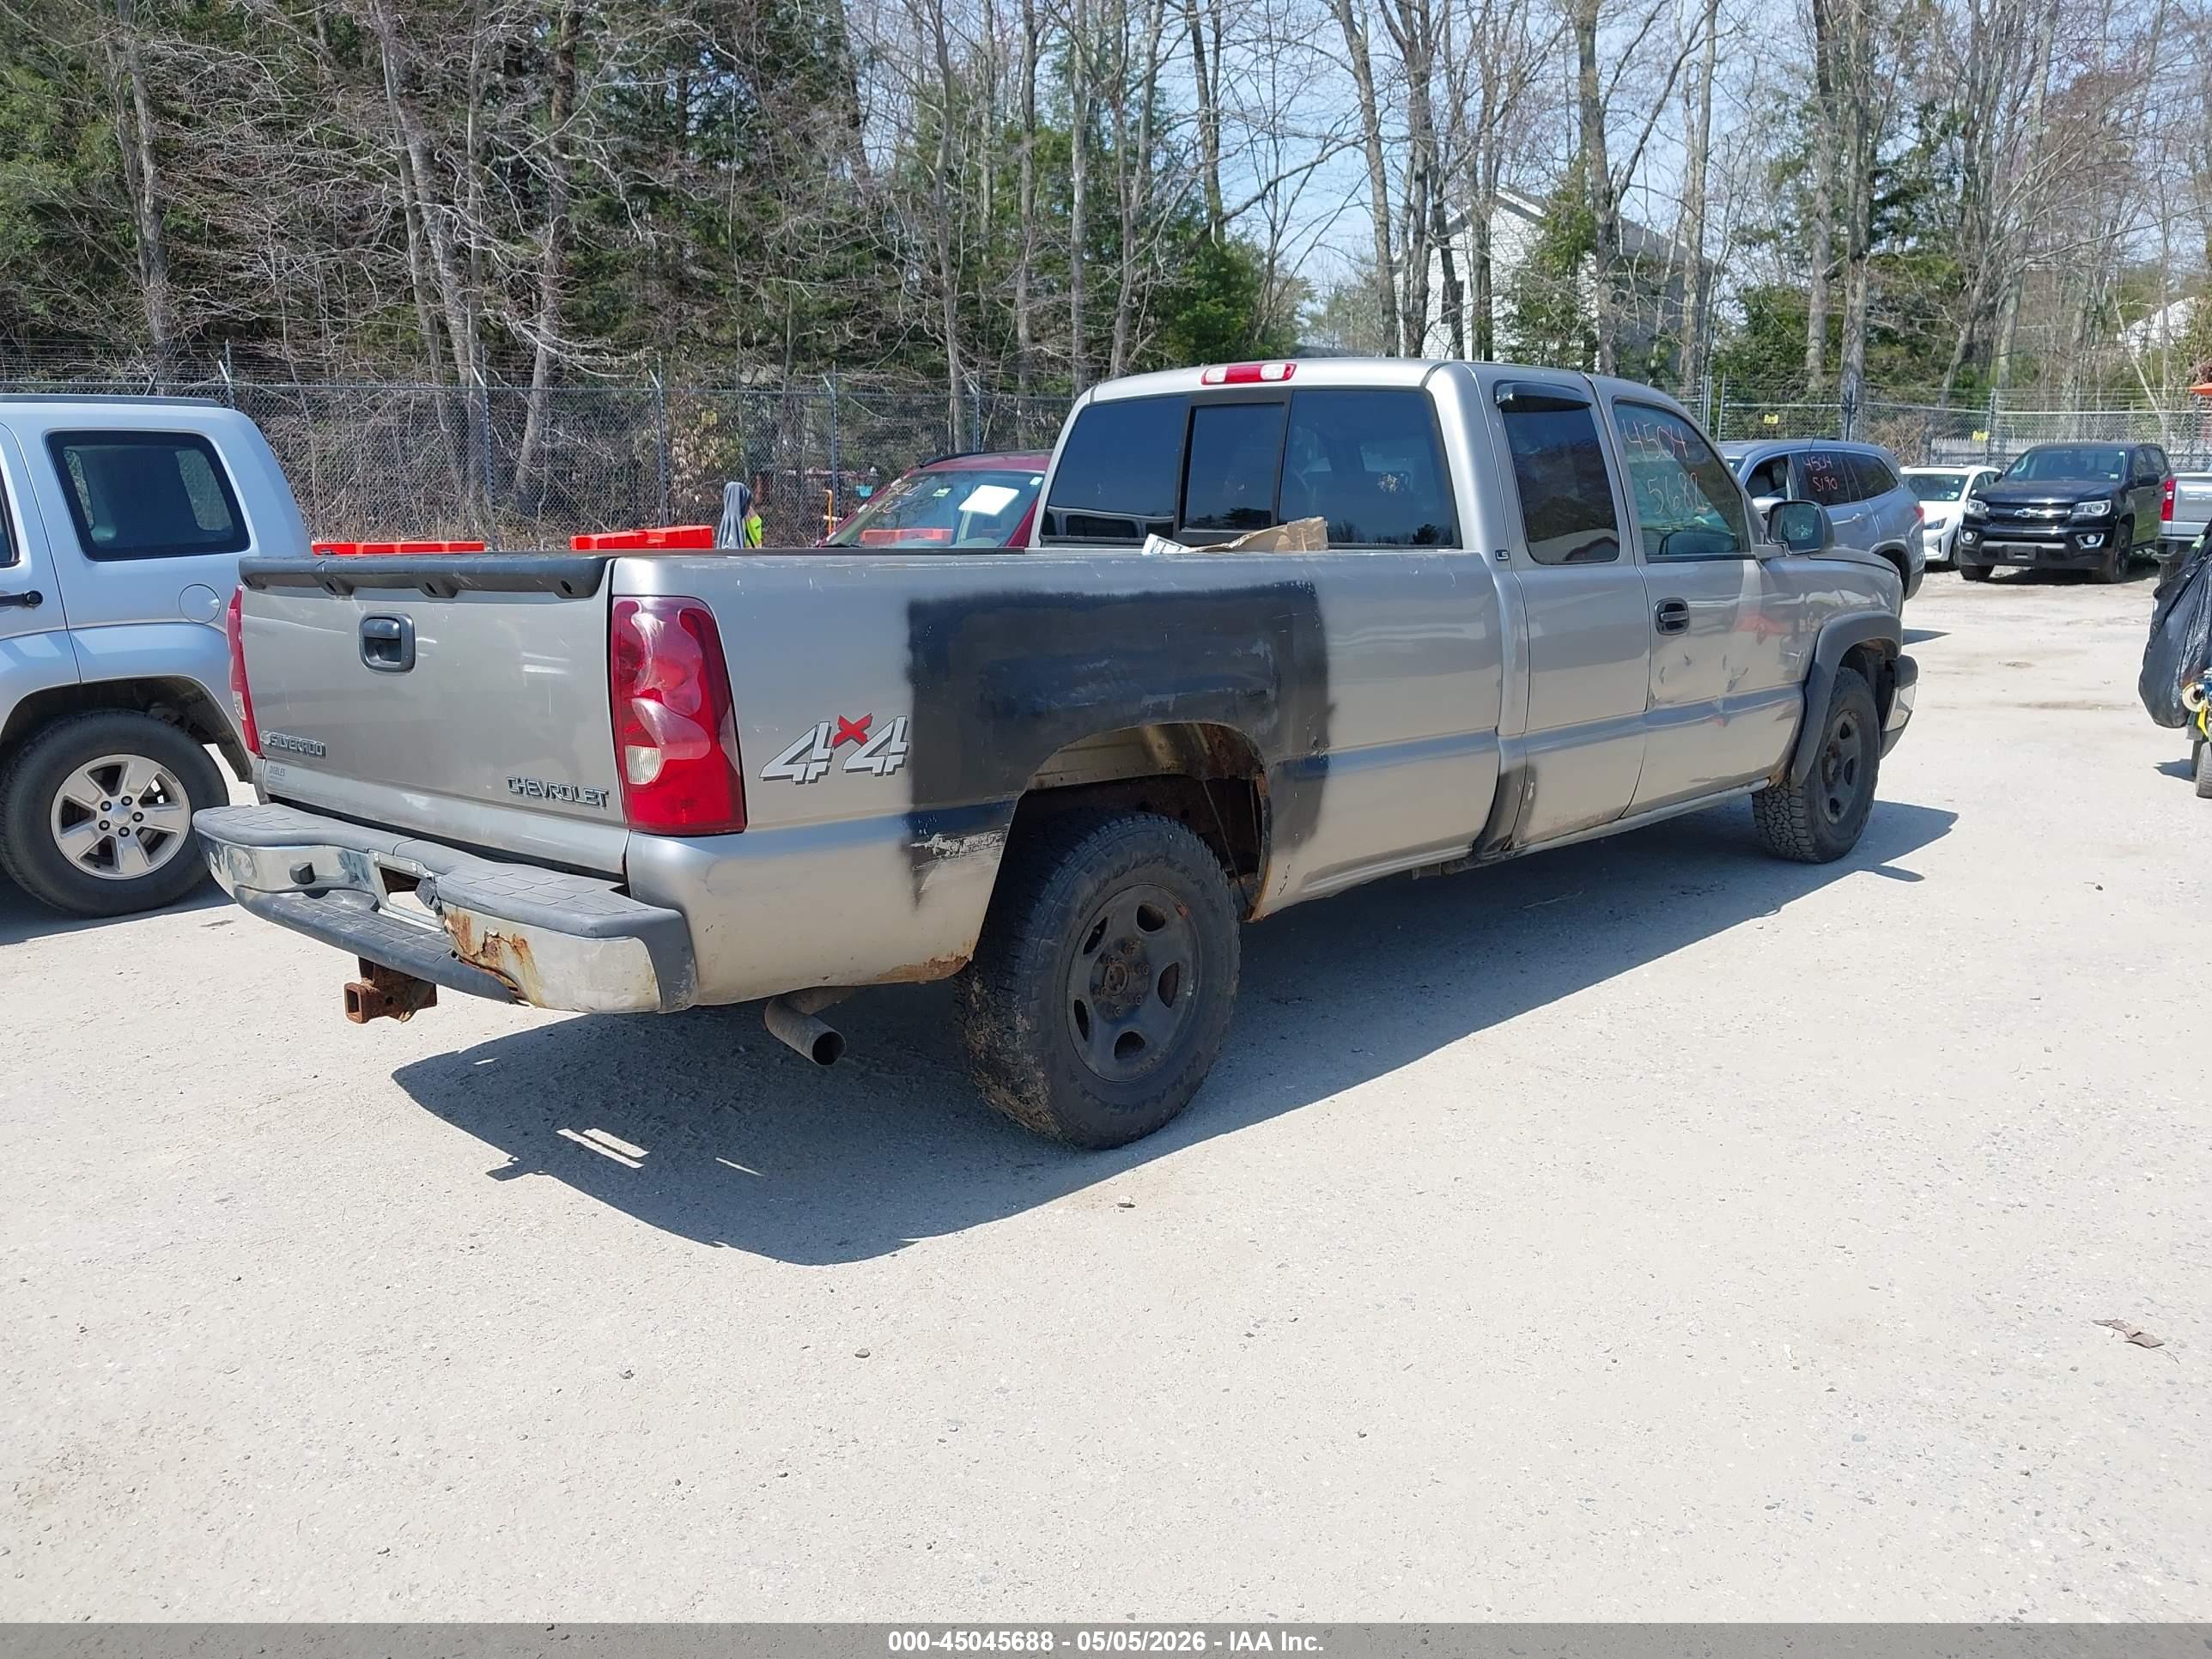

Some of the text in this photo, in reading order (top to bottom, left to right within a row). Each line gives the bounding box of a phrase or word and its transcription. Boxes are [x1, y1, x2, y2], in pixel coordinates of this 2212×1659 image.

[1622, 418, 1689, 461] 4504
[1813, 476, 1838, 492] 5190
[1496, 550, 1509, 561] LS
[270, 732, 326, 757] SILVERADO
[507, 776, 610, 808] CHEVROLET
